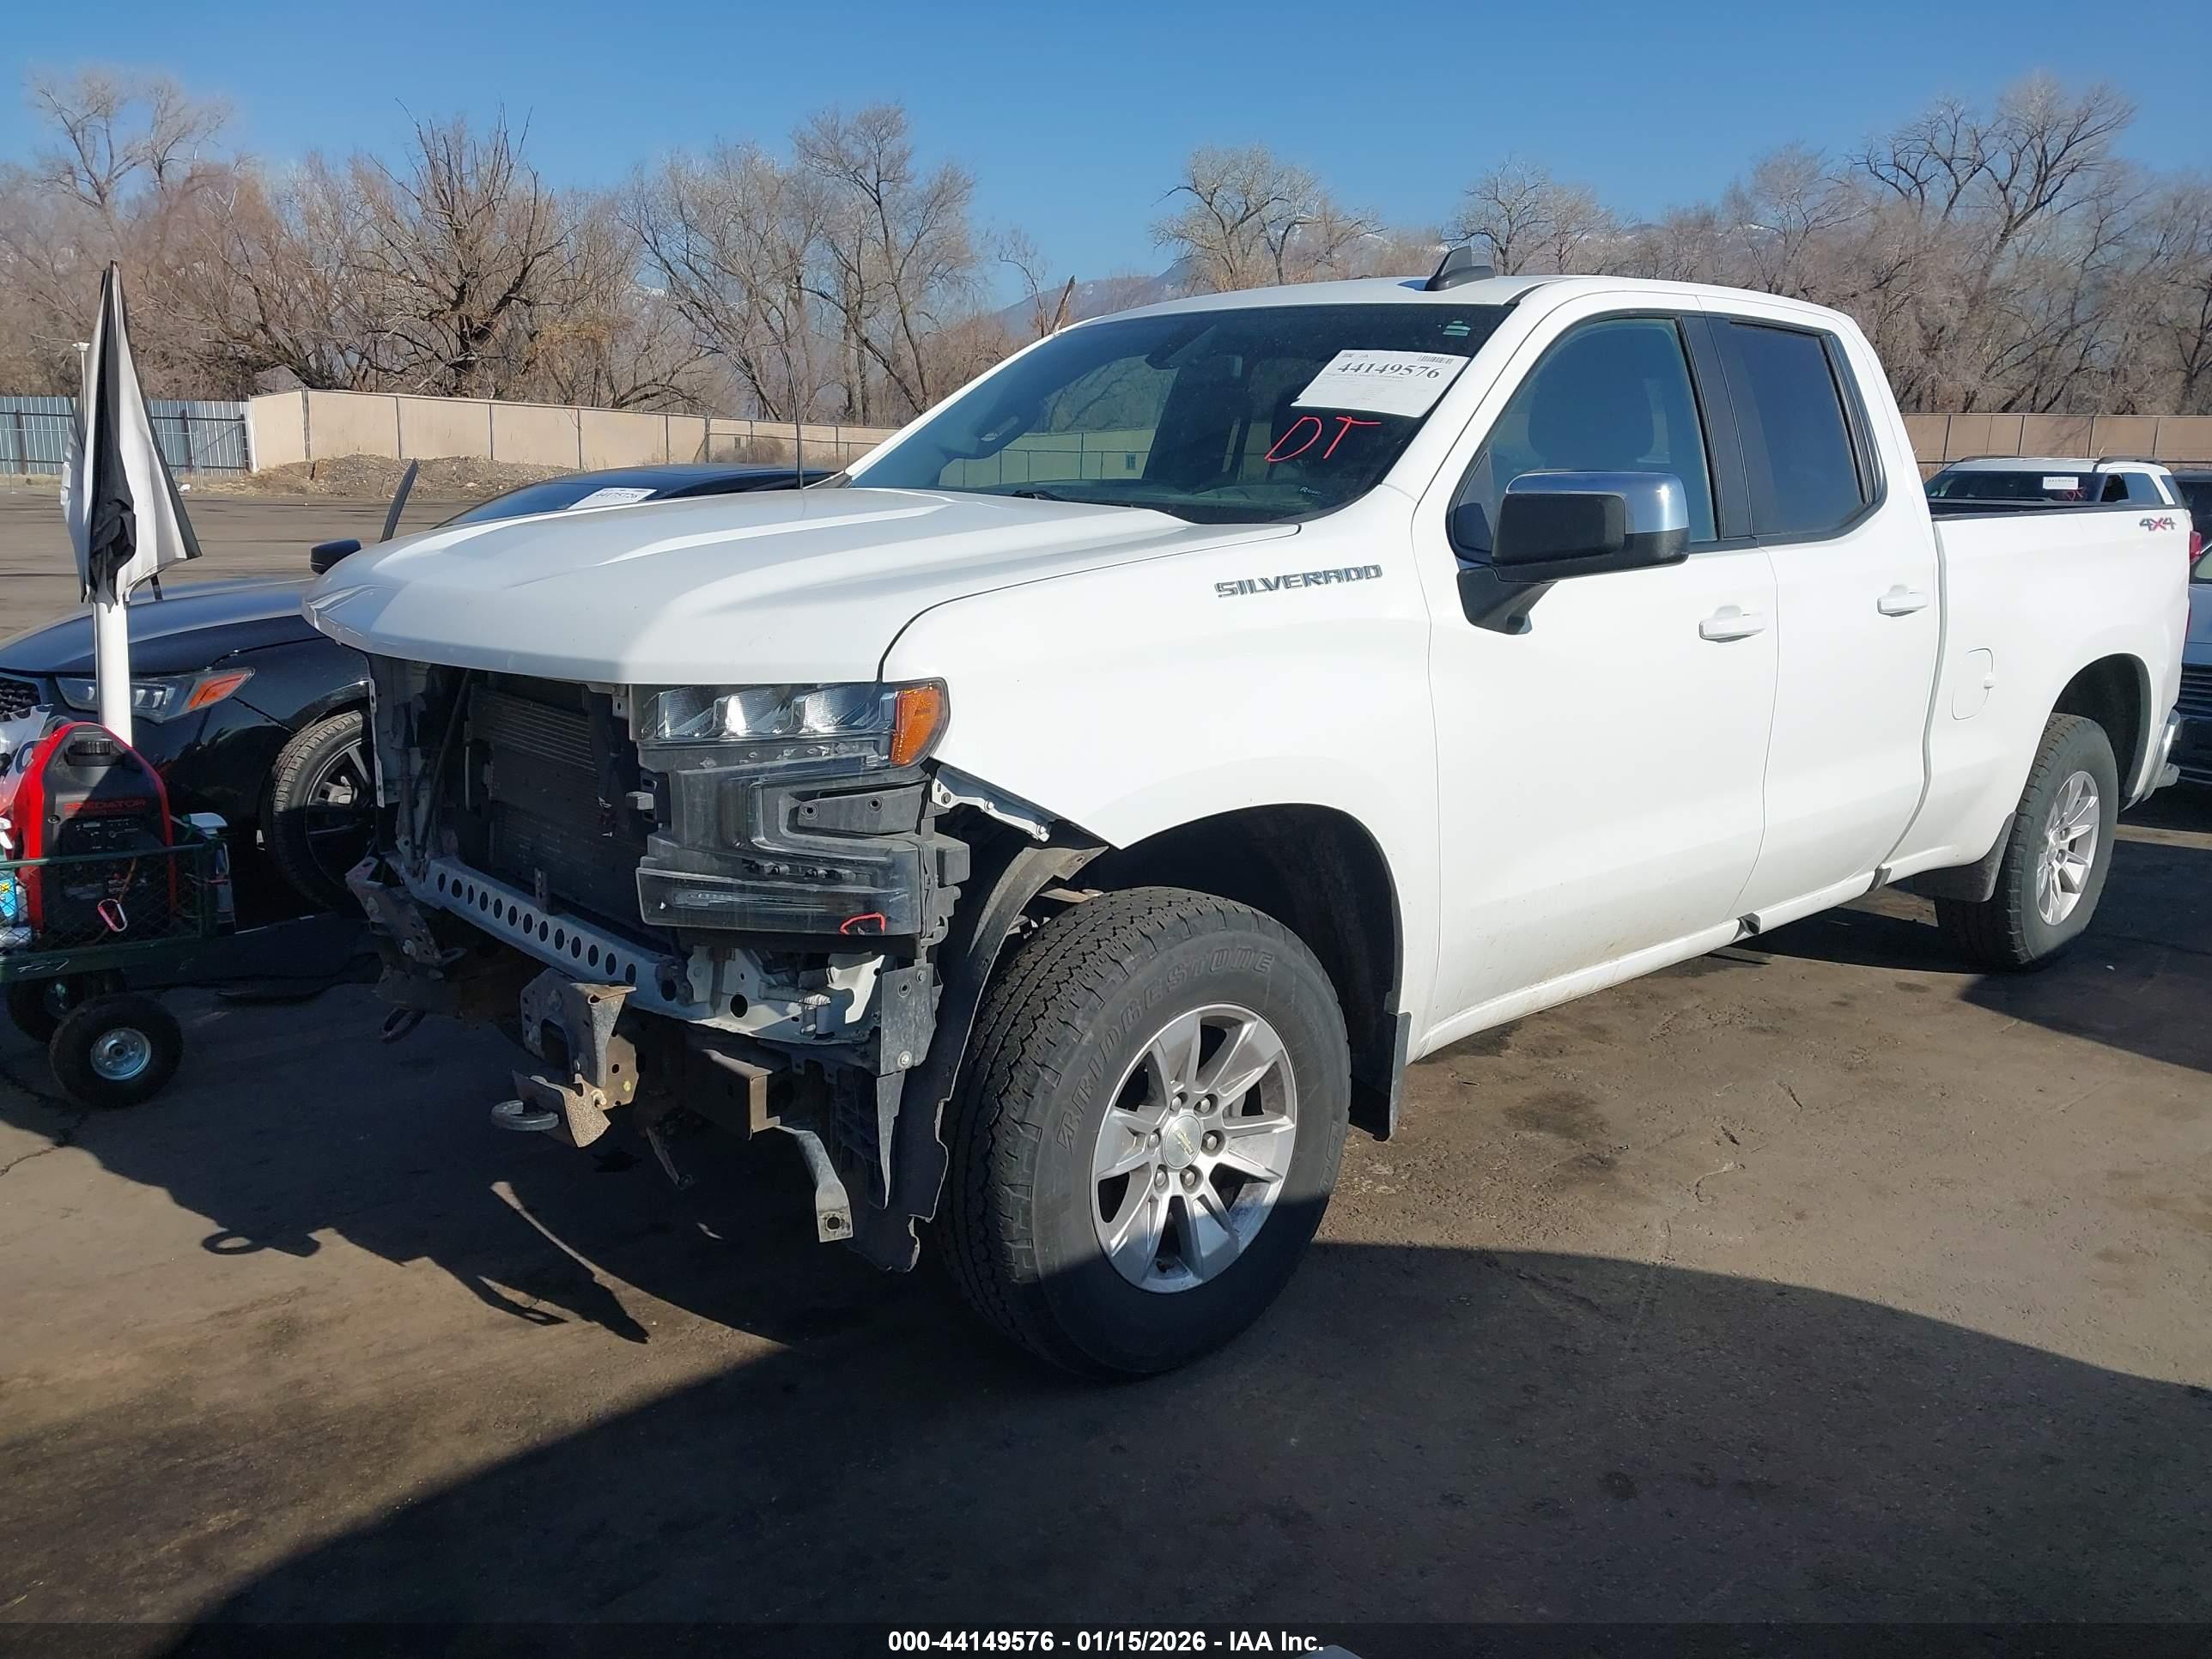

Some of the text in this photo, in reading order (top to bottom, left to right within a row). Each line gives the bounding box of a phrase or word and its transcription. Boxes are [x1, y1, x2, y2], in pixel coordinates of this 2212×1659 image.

[1338, 362, 1441, 379] 44149576
[1264, 416, 1381, 462] DT
[1214, 563, 1383, 598] SILVERADO
[1058, 947, 1274, 1155] BRIDGESTONE
